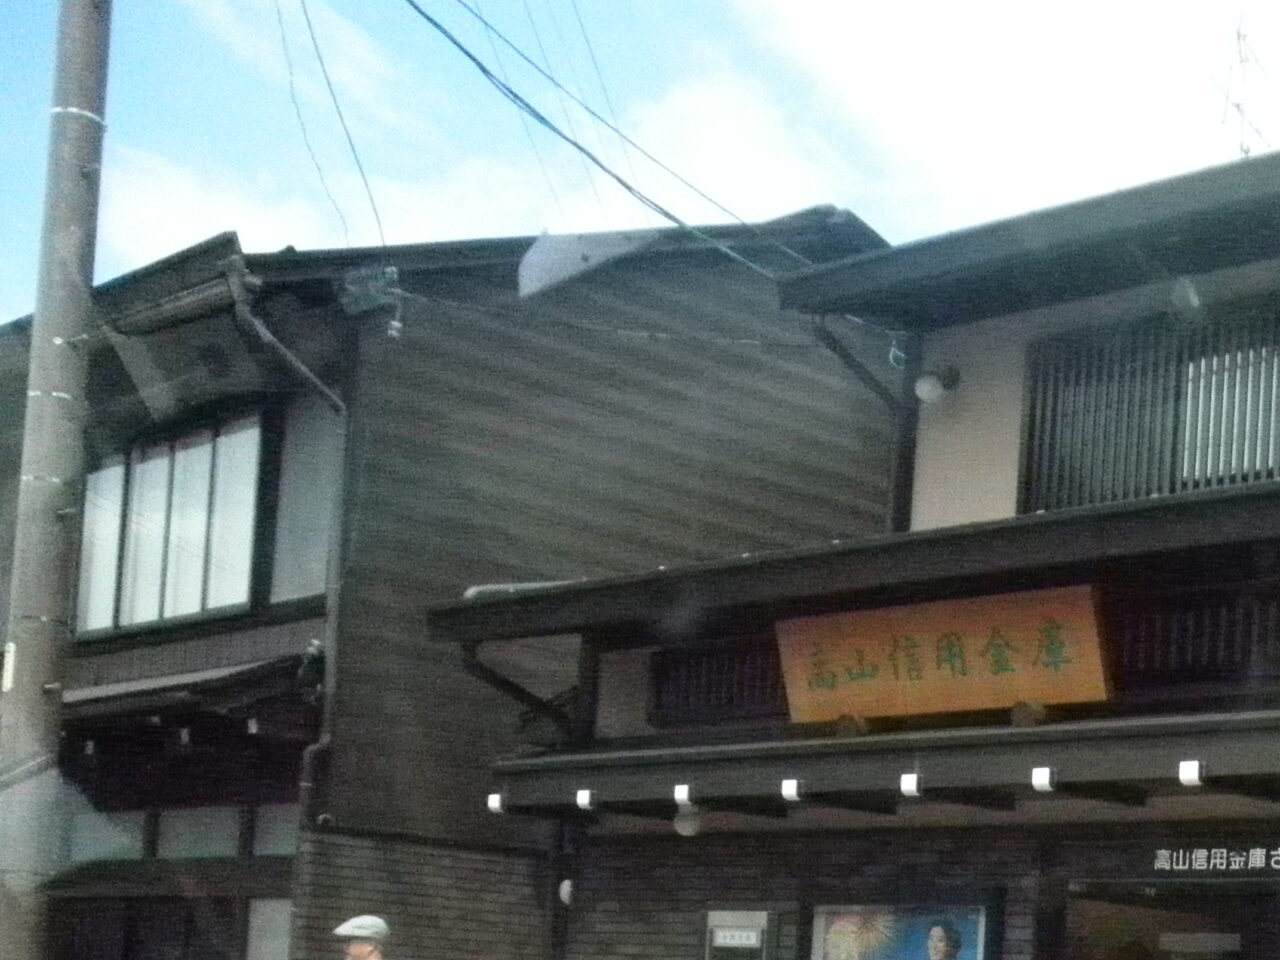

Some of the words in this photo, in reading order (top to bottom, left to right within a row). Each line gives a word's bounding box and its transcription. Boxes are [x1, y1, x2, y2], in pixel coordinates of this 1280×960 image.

[807, 617, 1073, 692] 高山信用金庫
